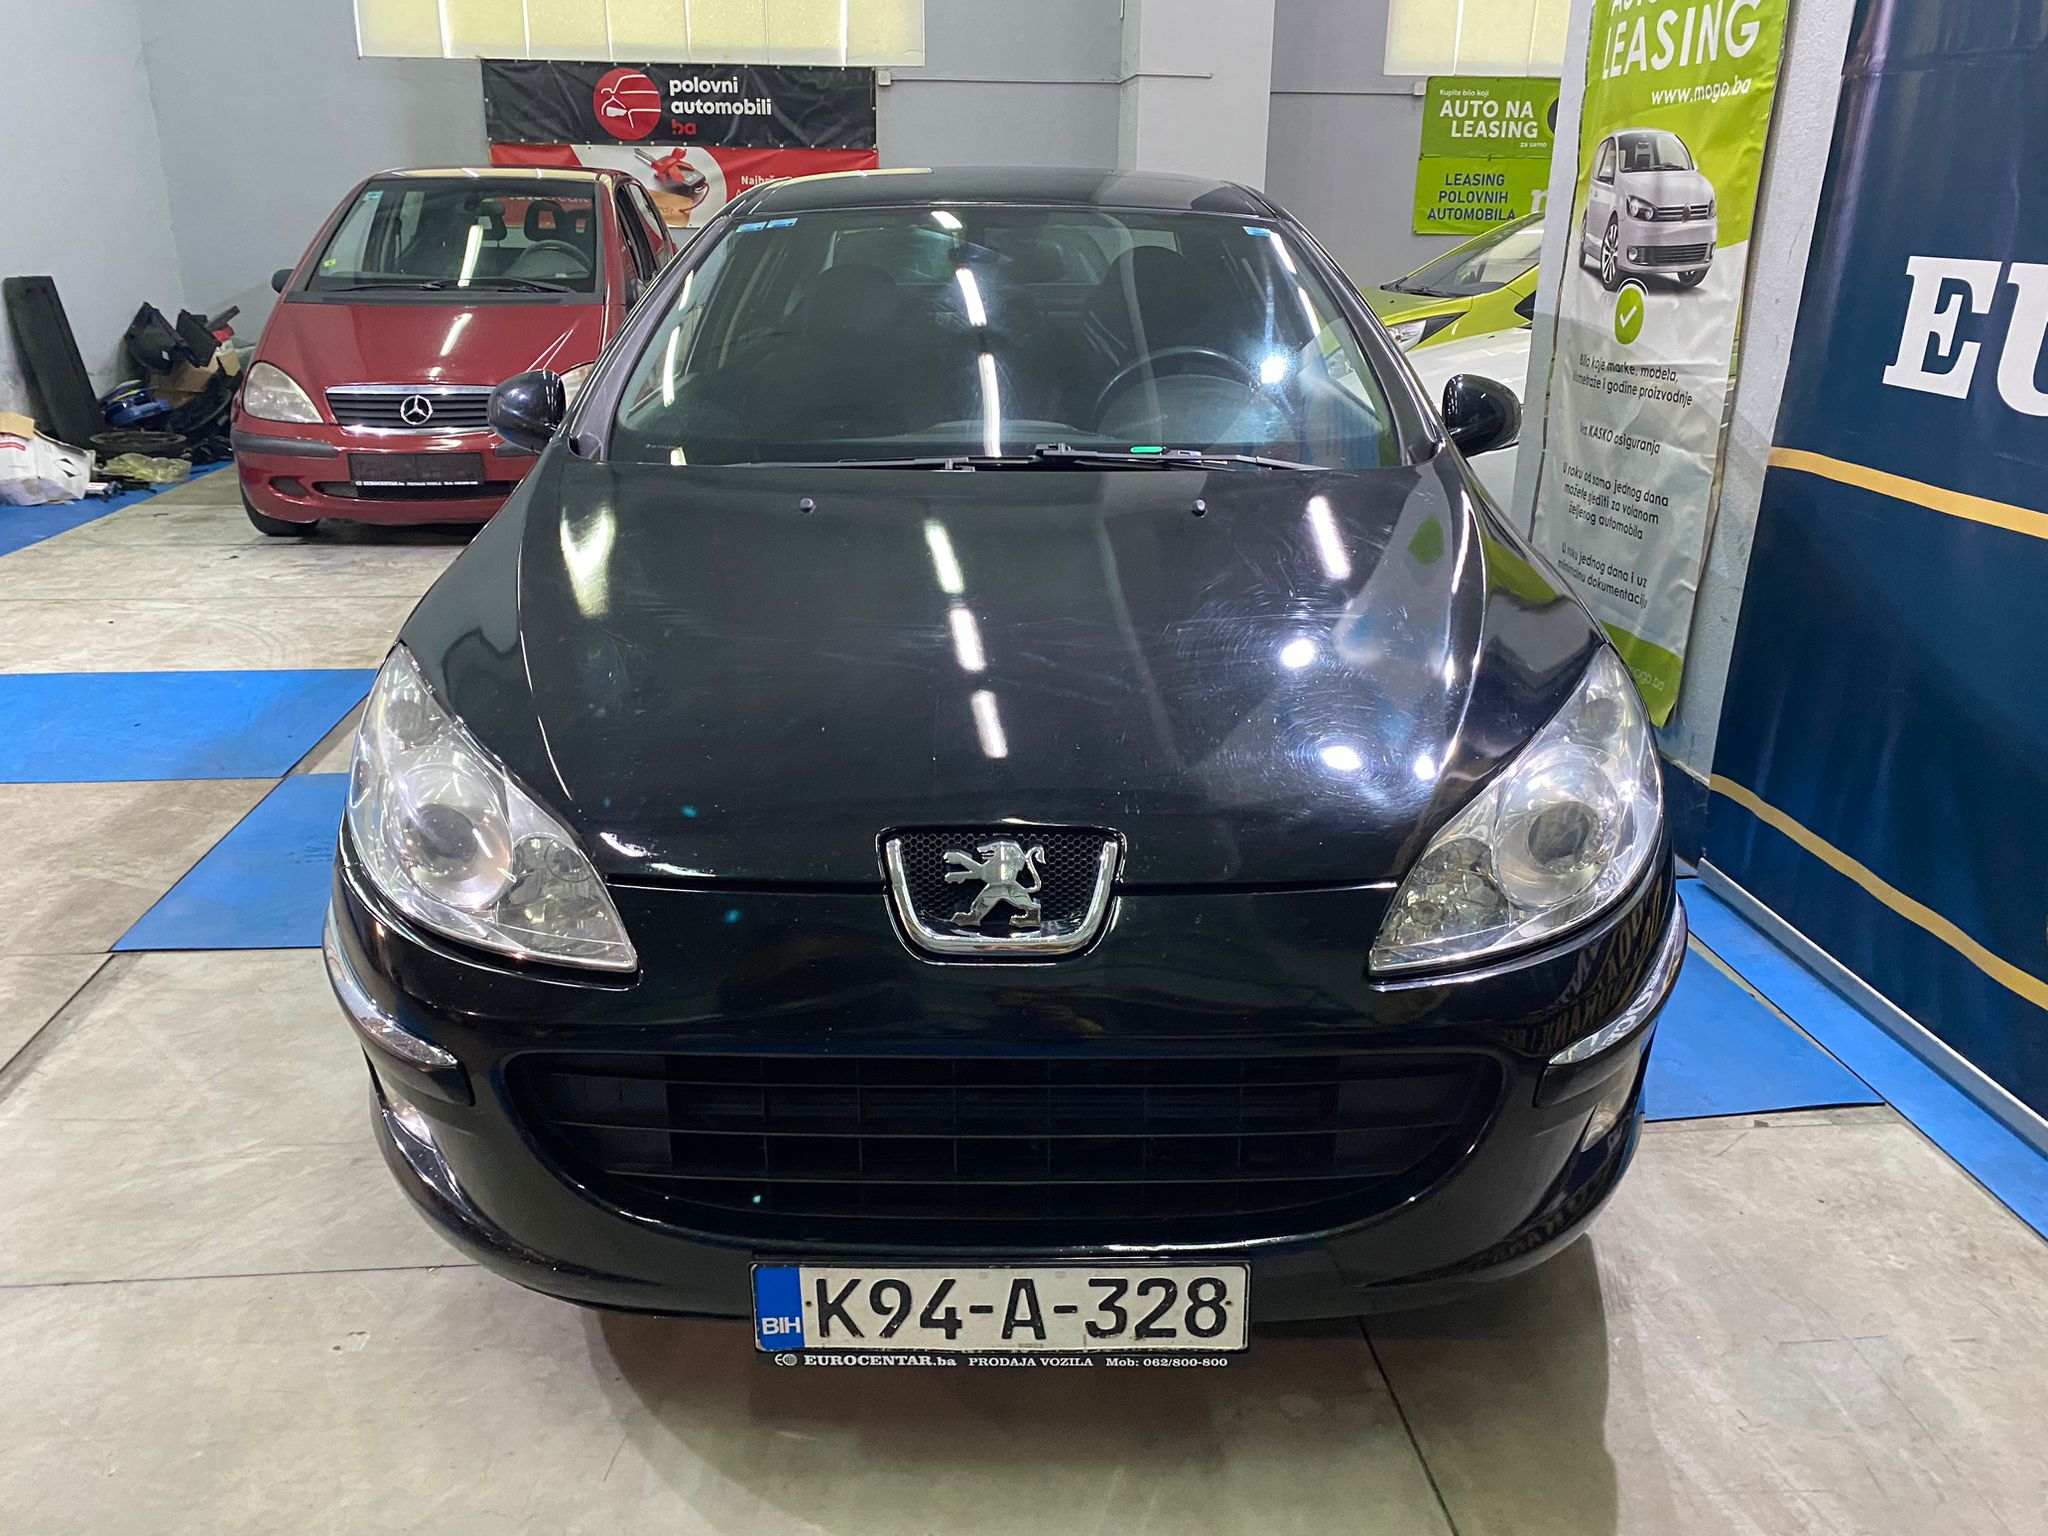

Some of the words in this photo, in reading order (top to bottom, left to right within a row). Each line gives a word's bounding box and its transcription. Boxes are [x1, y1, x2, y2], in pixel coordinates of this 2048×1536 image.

[1602, 0, 1760, 80] LEASING
[669, 76, 739, 97] polovni
[1462, 88, 1476, 97] bilo
[1476, 88, 1490, 98] koji
[1651, 75, 1752, 105] www.mogo.ba
[671, 98, 772, 115] automobili
[1439, 100, 1499, 118] AUTO
[1505, 100, 1534, 118] NA
[1451, 120, 1539, 139] LEASING
[1445, 173, 1505, 187] LEASING
[1438, 190, 1509, 204] POLOVNIH
[1427, 208, 1517, 221] AUTOMOBILA
[1591, 355, 1606, 374] koje
[1606, 361, 1639, 377] marke,
[1640, 366, 1679, 384] modela,
[1607, 380, 1637, 395] godine
[1639, 385, 1693, 408] proizvodnje
[1588, 424, 1614, 443] KASKO
[1613, 433, 1660, 456] osiguranja
[1567, 465, 1583, 480] roku
[1592, 475, 1612, 491] samo
[1612, 479, 1642, 503] jednog
[1643, 489, 1669, 507] dana
[1564, 483, 1588, 501] možete
[1611, 499, 1621, 512] za
[1622, 504, 1660, 525] volanom
[1598, 514, 1643, 540] automobila
[1578, 551, 1606, 576] jednog
[1607, 563, 1629, 582] dana
[1636, 575, 1648, 588] uz
[761, 1316, 801, 1335] BIH
[816, 1276, 1228, 1340] K94-A-328
[803, 1354, 958, 1367] EUROCENTAR.ba
[968, 1357, 1037, 1368] PRODAJA
[1039, 1357, 1094, 1368] VOZILA
[1105, 1357, 1139, 1368] Mob:
[1142, 1357, 1228, 1368] 062/800-800
